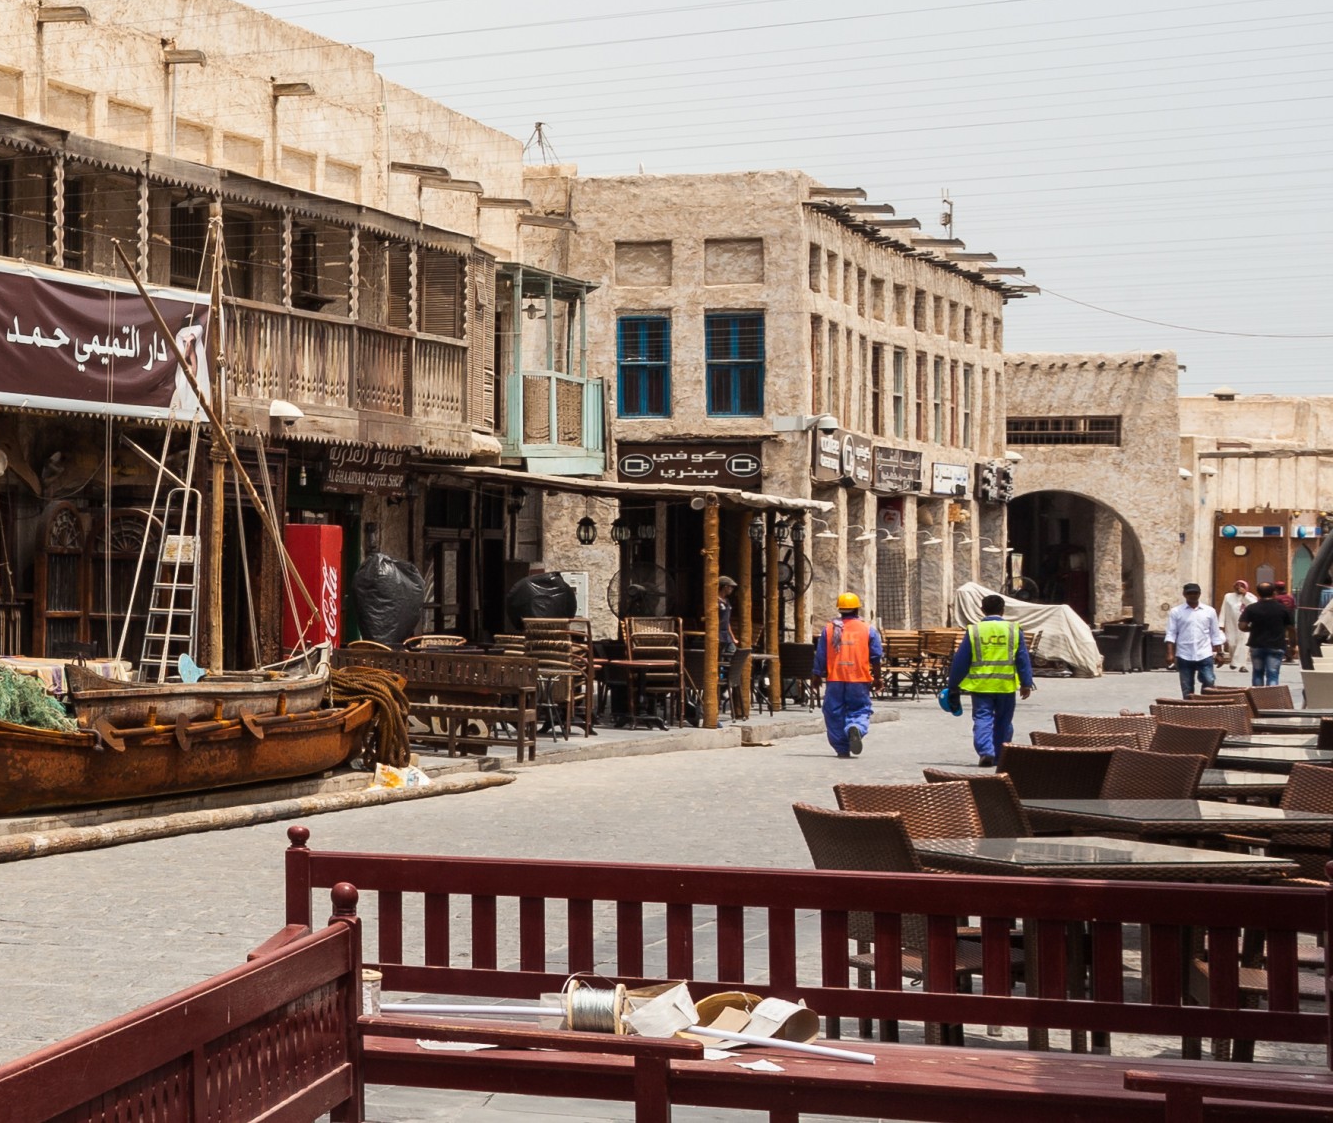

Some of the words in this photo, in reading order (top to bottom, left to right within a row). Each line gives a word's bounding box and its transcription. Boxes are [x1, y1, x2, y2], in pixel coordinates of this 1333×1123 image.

[5, 315, 71, 349] حمد
[74, 325, 140, 372] التميمي
[142, 332, 168, 371] دار
[652, 450, 727, 463] كوفي
[366, 472, 388, 488] COFFEE
[387, 474, 404, 488] SHOP
[979, 634, 1007, 646] UCC
